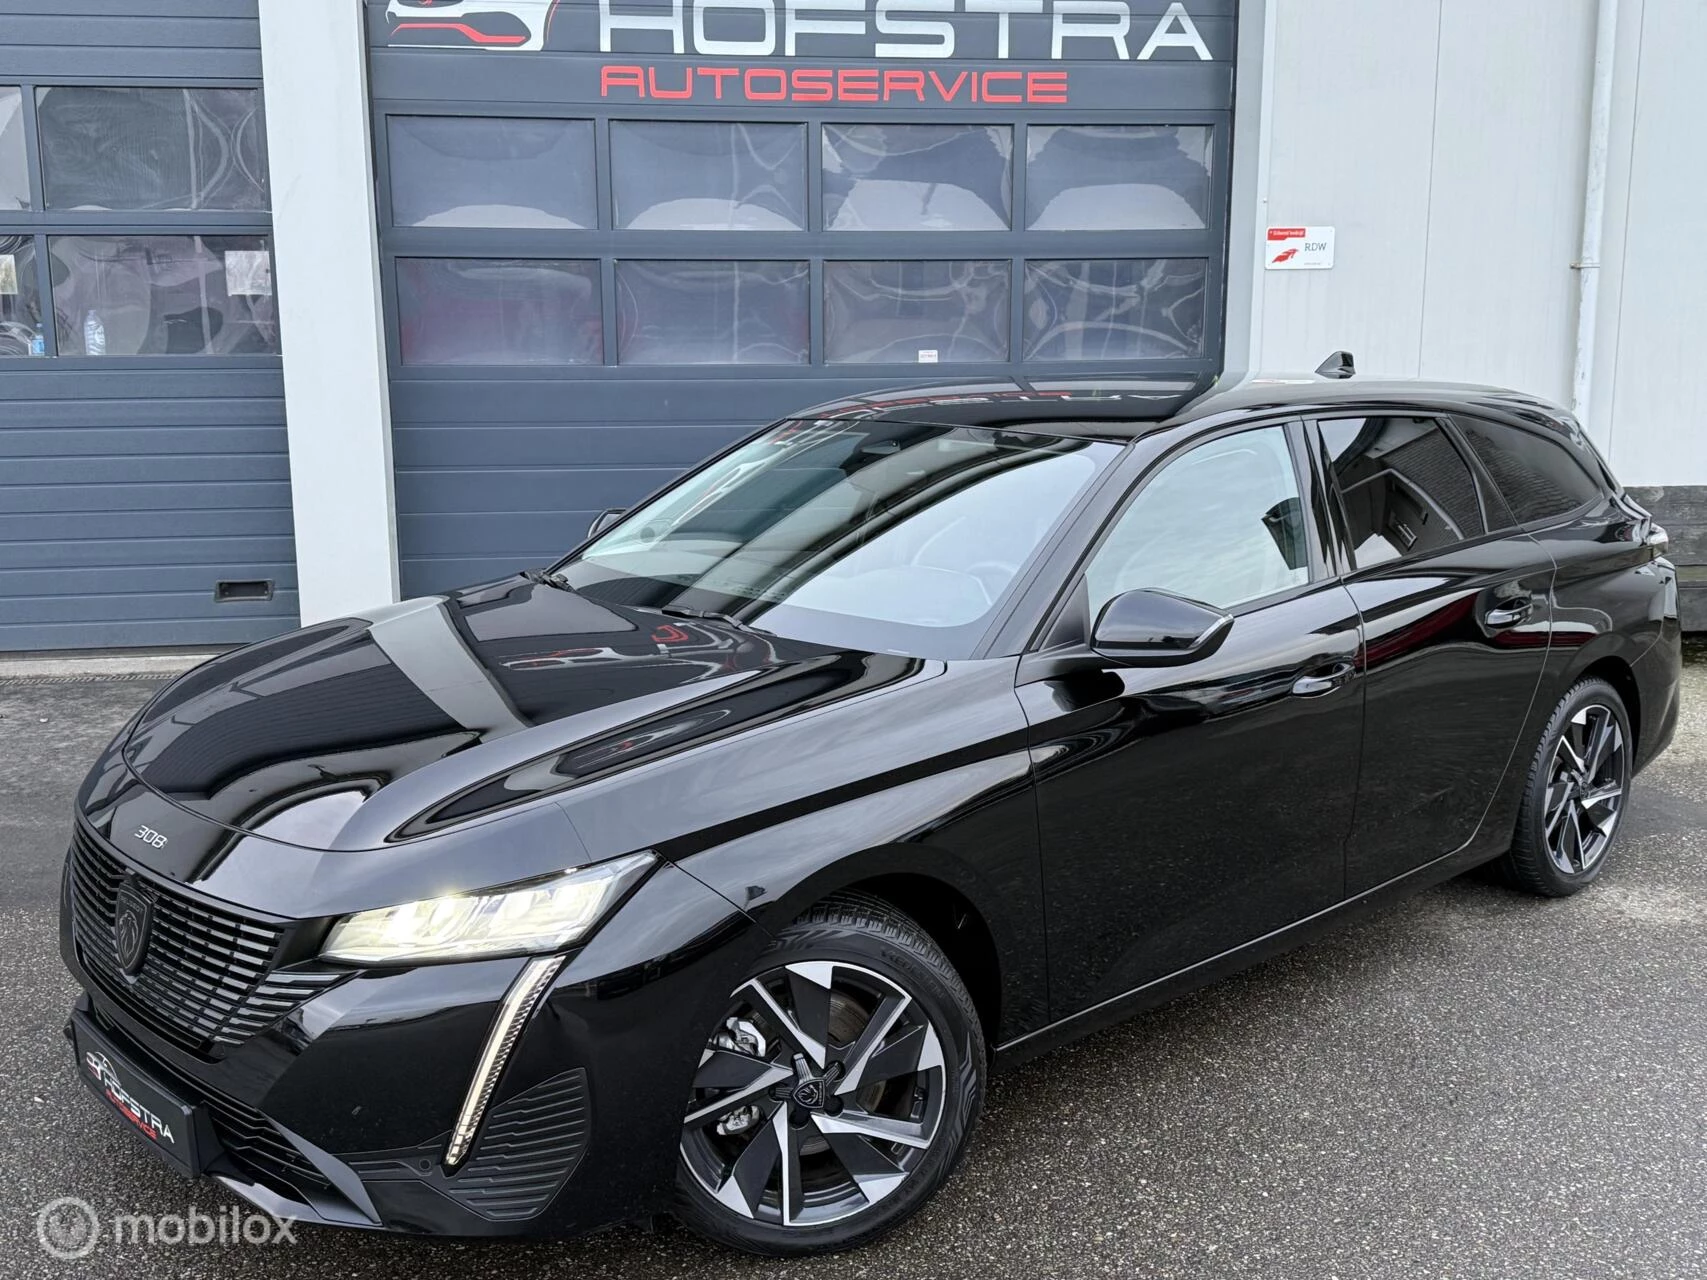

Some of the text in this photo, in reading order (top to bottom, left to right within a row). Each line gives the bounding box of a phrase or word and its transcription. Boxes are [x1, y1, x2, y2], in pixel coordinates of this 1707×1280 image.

[600, 0, 1213, 60] HOFSTRA
[601, 66, 1068, 103] AUTOSERVICE
[1304, 242, 1327, 252] RDW
[134, 825, 169, 849] 308
[103, 1071, 175, 1144] HOFSTRA
